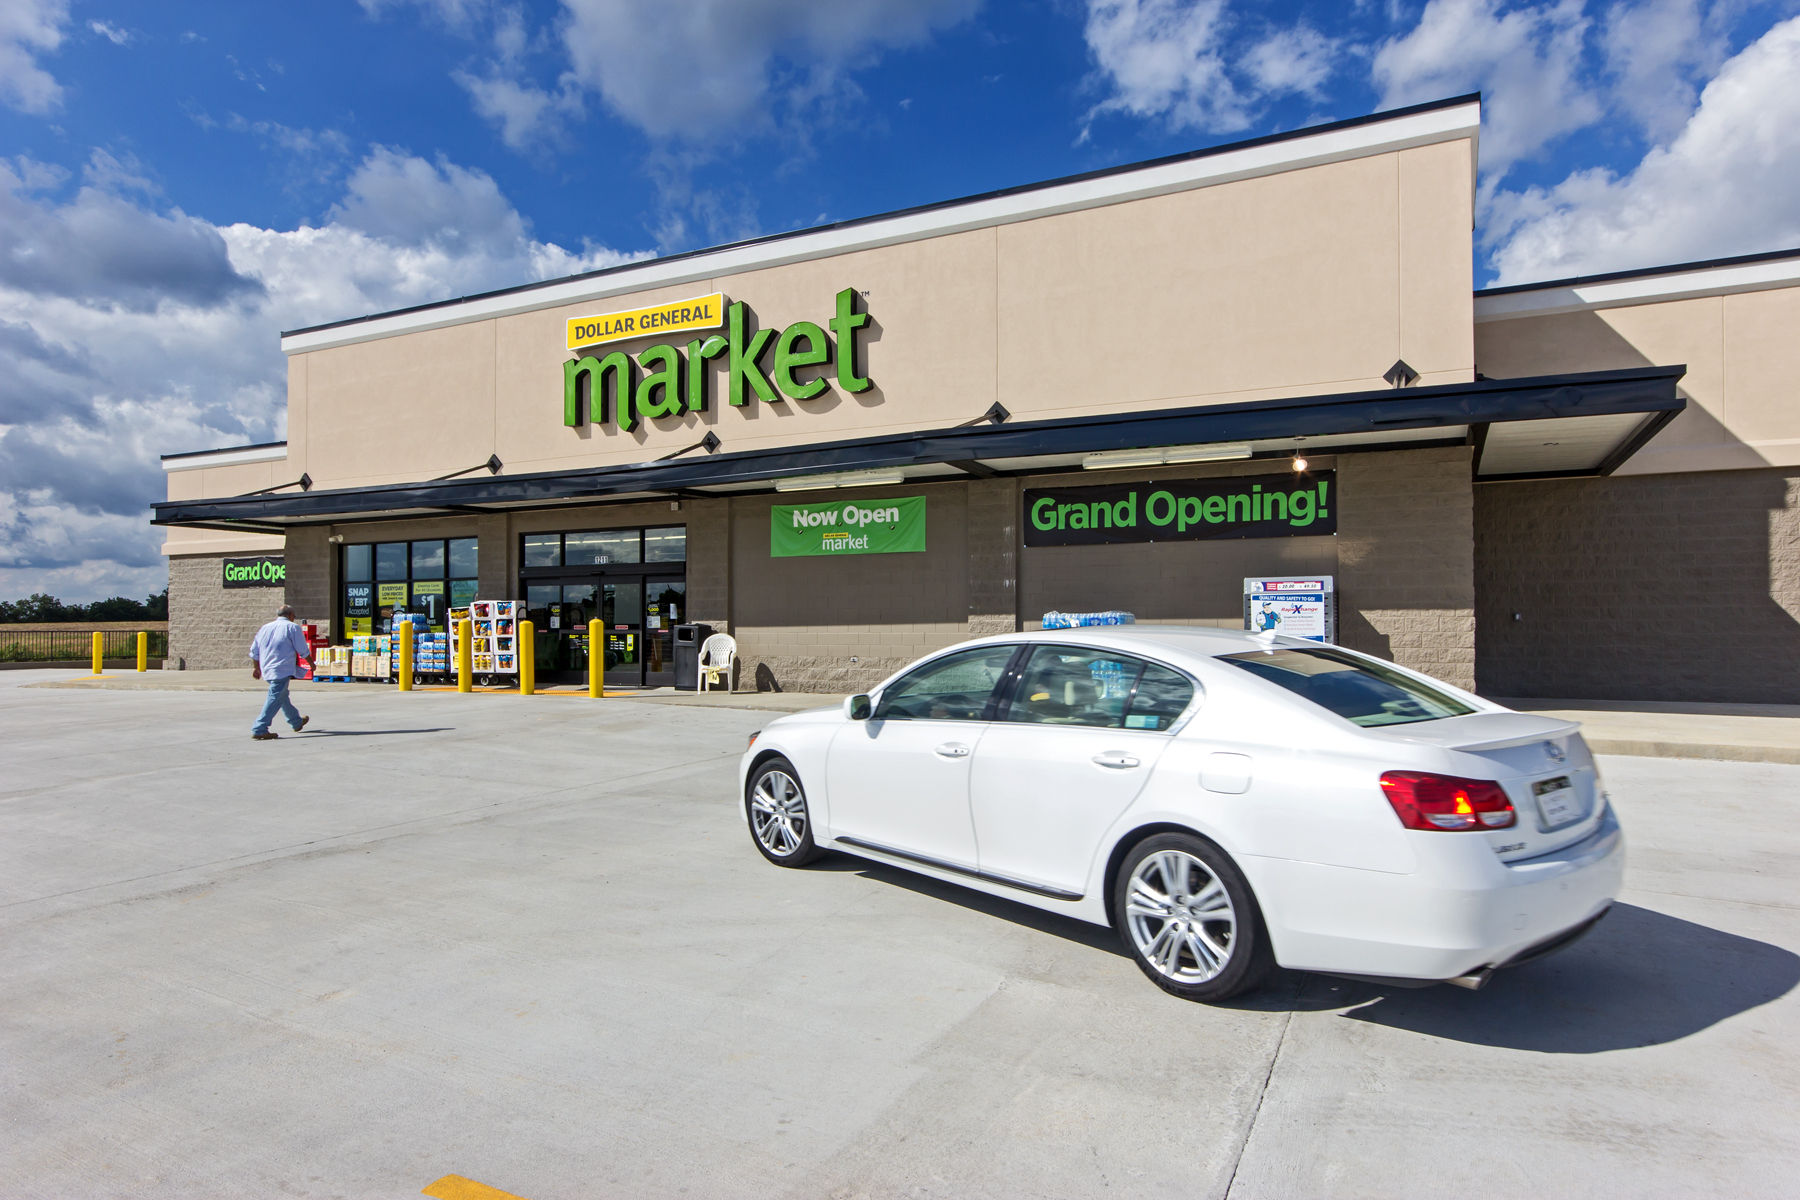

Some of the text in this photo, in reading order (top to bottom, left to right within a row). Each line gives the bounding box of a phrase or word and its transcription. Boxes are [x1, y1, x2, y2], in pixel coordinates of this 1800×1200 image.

[575, 304, 713, 340] DOLLAR GENERAL
[563, 287, 871, 432] market
[793, 505, 900, 528] Now Open
[1031, 481, 1329, 532] Grand Opening!
[822, 534, 869, 551] market
[225, 561, 261, 581] Grand
[348, 588, 369, 597] SNAP
[354, 598, 368, 606] EBT
[422, 595, 434, 618] $1
